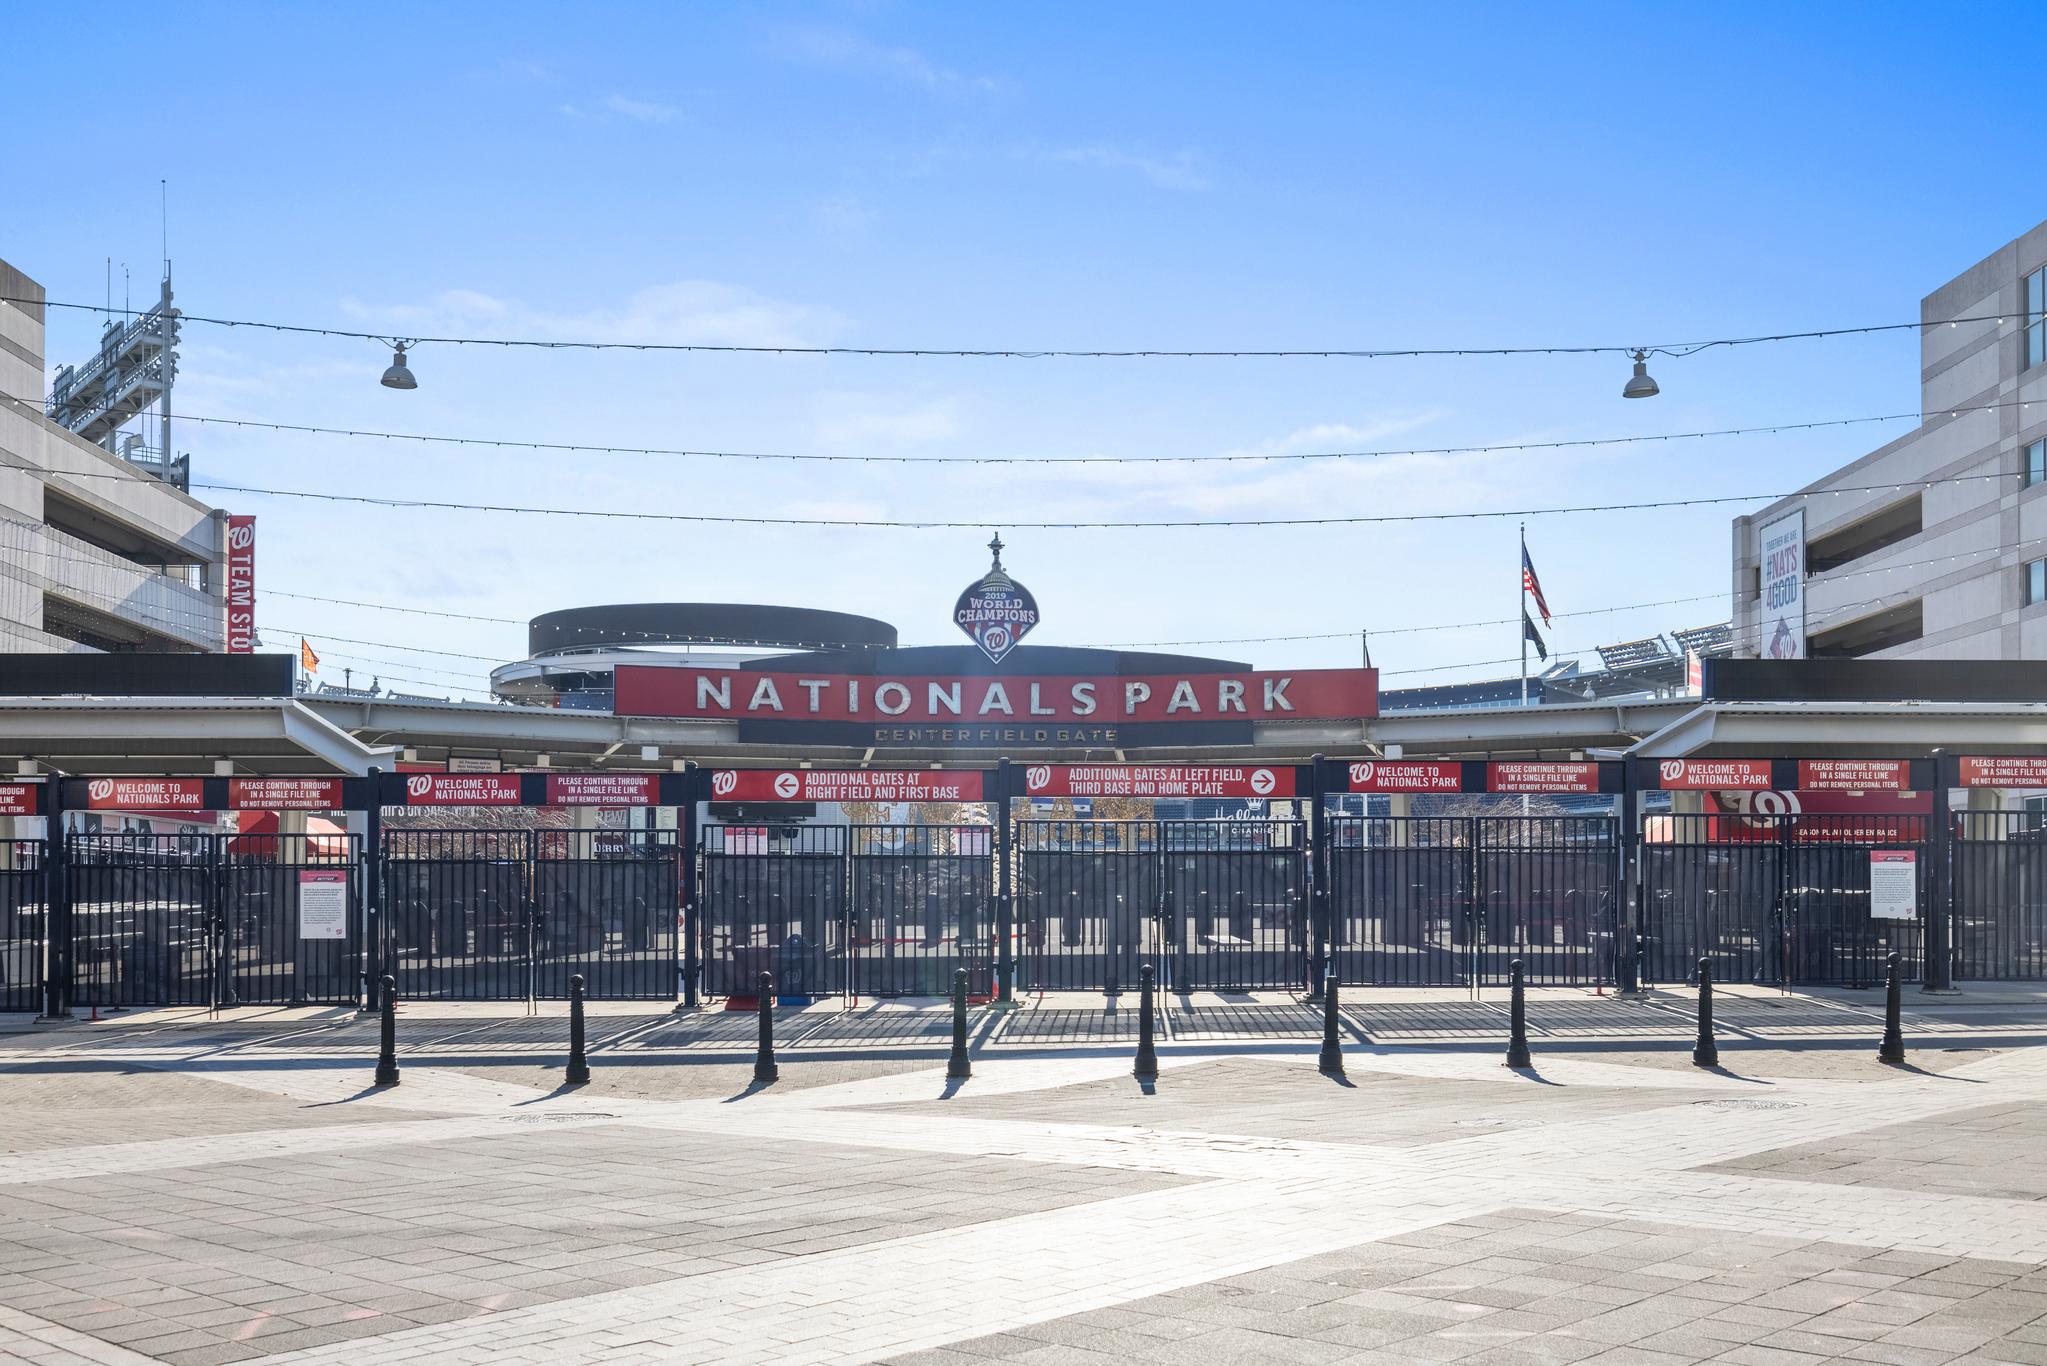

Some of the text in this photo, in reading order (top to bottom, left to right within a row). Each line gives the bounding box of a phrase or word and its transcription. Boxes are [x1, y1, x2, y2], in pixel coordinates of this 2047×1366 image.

[1766, 544, 1798, 582] #NATS
[1766, 575, 1798, 611] 4GOOD
[230, 554, 251, 654] TEAM STO
[970, 598, 1023, 609] WORLD
[958, 609, 1036, 624] CHAMPIONS
[696, 676, 1296, 716] NATIONALS PARK
[875, 728, 1118, 742] CENTER FIELD GATE
[1377, 767, 1439, 776] WELCOME TO
[1688, 764, 1750, 774] WELCOME TO
[805, 773, 920, 785] ADDITIONAL GATES AT
[1069, 769, 1245, 783] ADDITIONAL GATES AT LEFT FIELD,
[1688, 775, 1768, 784] NATIONALS PARK
[117, 784, 180, 793] WELCOME TO
[435, 779, 498, 789] WELCOME TO
[1069, 782, 1223, 794] THIRD BASE AND HOME PLATE
[1377, 778, 1457, 787] NATIONALS PARK
[117, 794, 199, 804] NATIONALS PARK
[435, 790, 516, 799] NATIONALS PARK
[806, 787, 959, 799] RIGHT FIELD AND FIRST BASE
